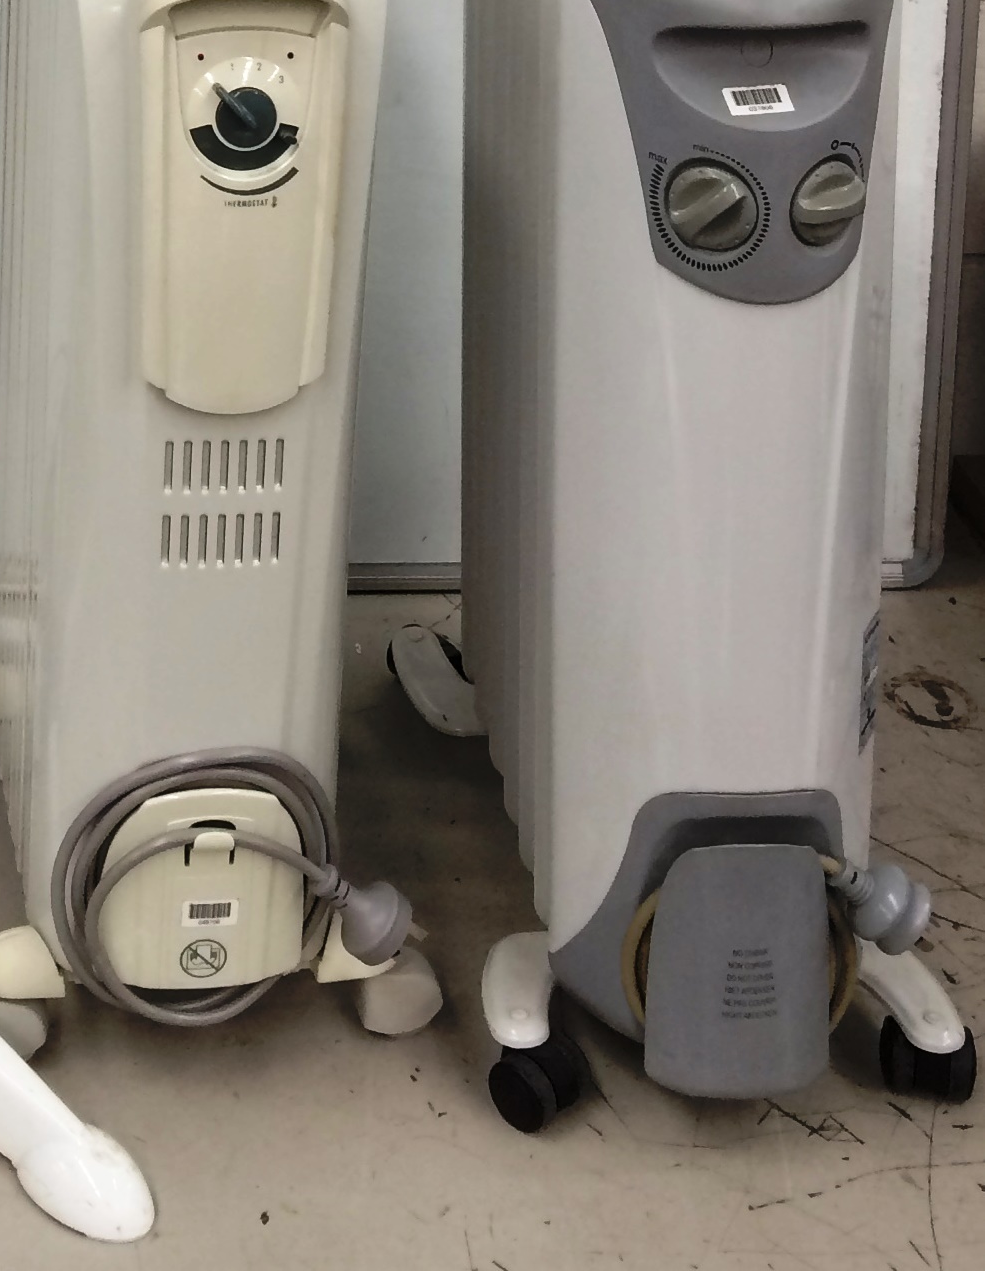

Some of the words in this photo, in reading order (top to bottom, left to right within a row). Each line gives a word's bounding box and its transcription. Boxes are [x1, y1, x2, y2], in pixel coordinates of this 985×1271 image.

[256, 62, 263, 72] 2
[278, 75, 285, 84] 3
[692, 144, 709, 153] min
[648, 151, 668, 165] max
